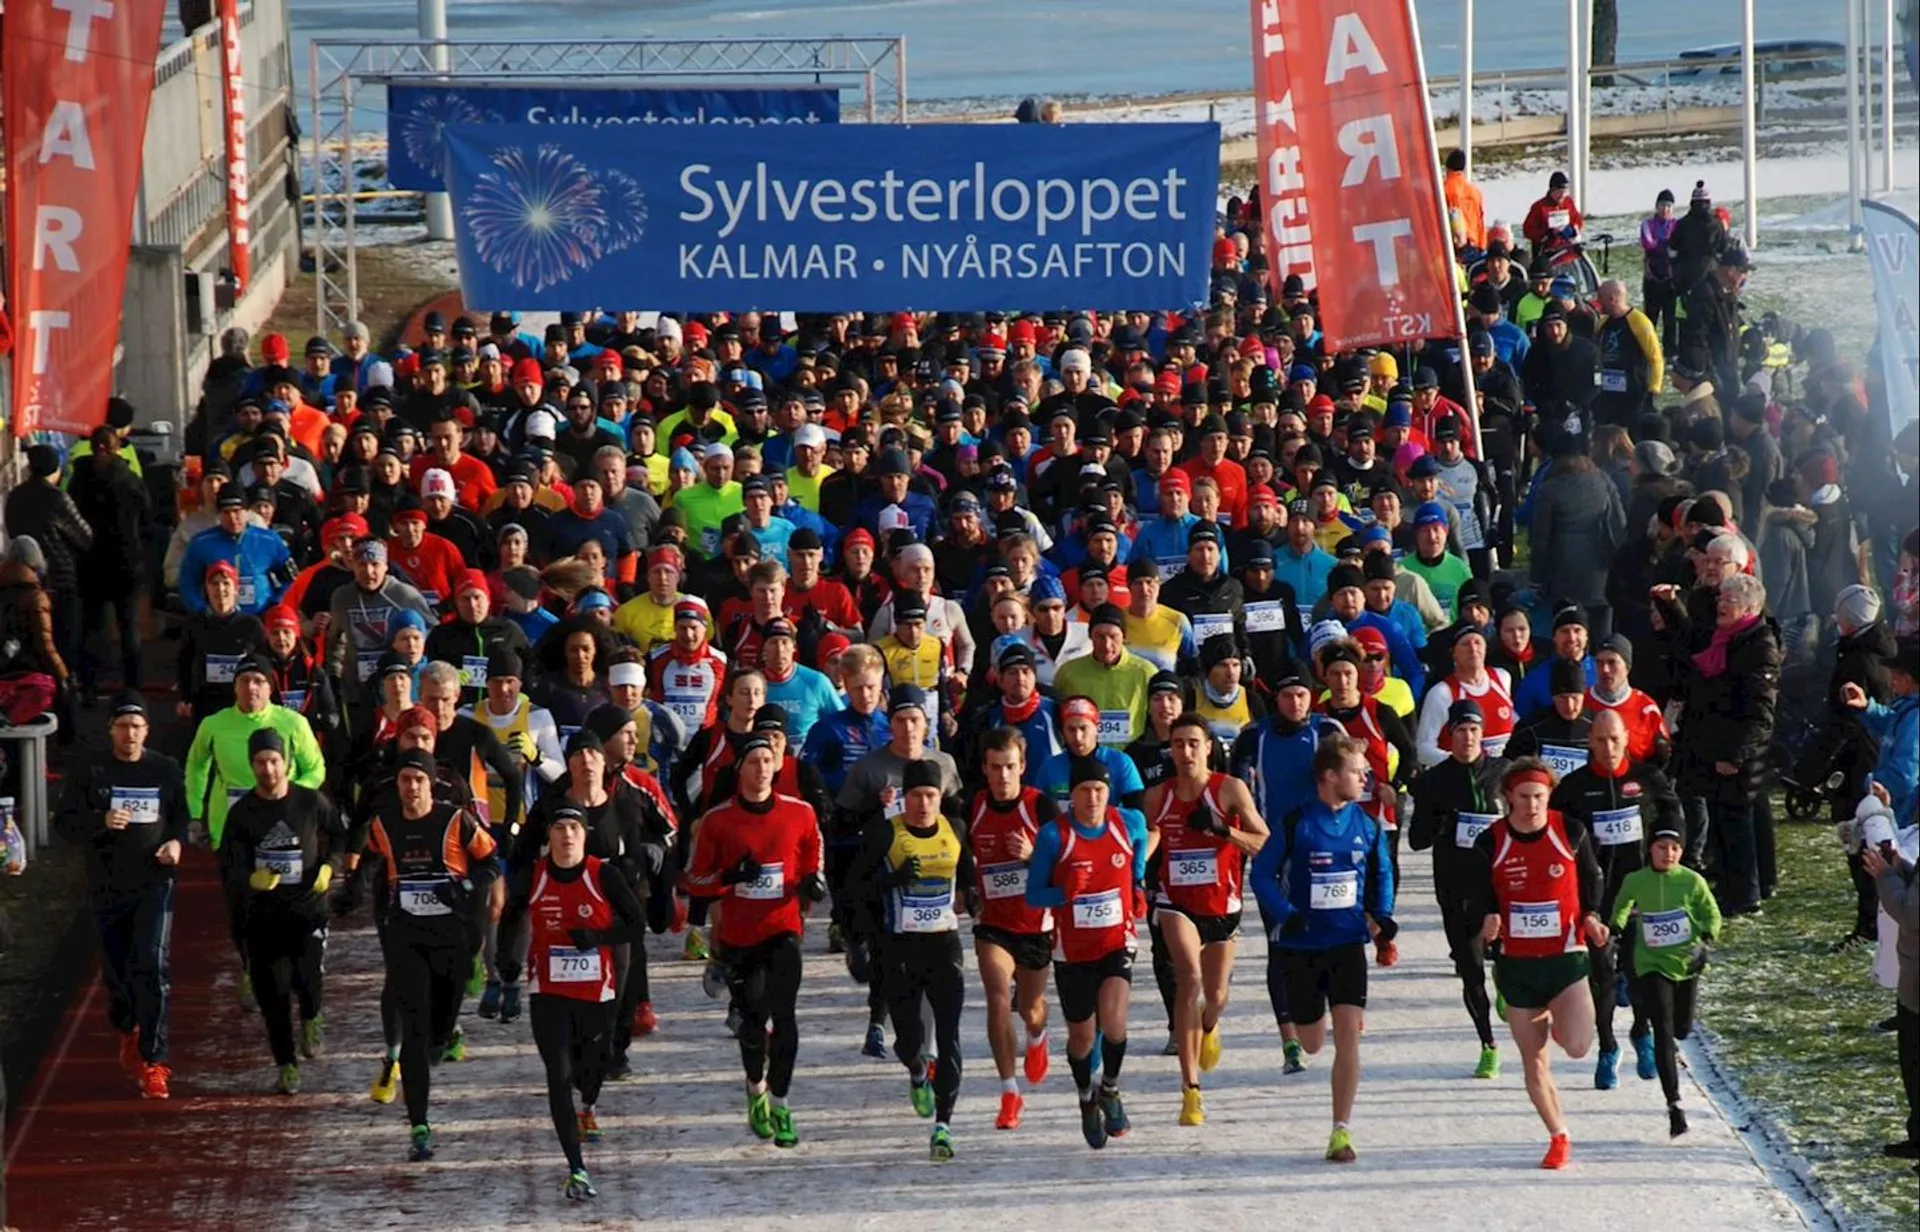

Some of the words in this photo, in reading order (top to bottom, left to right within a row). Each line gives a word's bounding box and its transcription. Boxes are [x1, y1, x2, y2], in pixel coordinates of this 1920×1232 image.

[679, 161, 1187, 238] Sylvesterloppet
[679, 243, 858, 279] KALMAR
[902, 234, 1186, 279] NYÅRSAFTON
[1604, 820, 1632, 834] 418
[1179, 861, 1207, 875] 365
[992, 873, 1020, 888] 586
[1322, 885, 1348, 898] 769
[913, 908, 941, 922] 369
[1085, 903, 1112, 918] 755
[1520, 914, 1549, 928] 156
[1652, 922, 1680, 937] 290
[561, 958, 590, 971] 770
